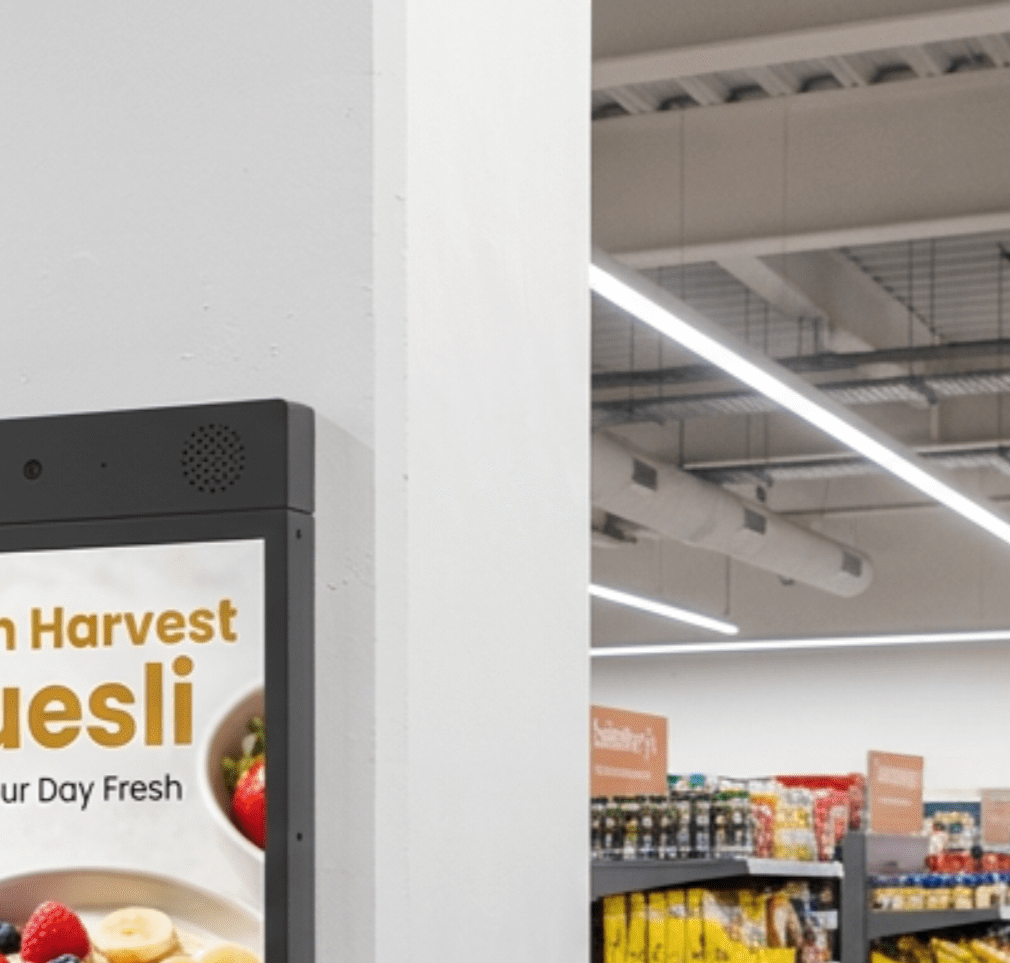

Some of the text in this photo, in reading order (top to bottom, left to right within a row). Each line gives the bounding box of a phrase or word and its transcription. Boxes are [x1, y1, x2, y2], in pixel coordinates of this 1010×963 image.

[32, 600, 236, 648] Harvest
[38, 777, 95, 811] Day
[103, 773, 183, 802] Fresh
